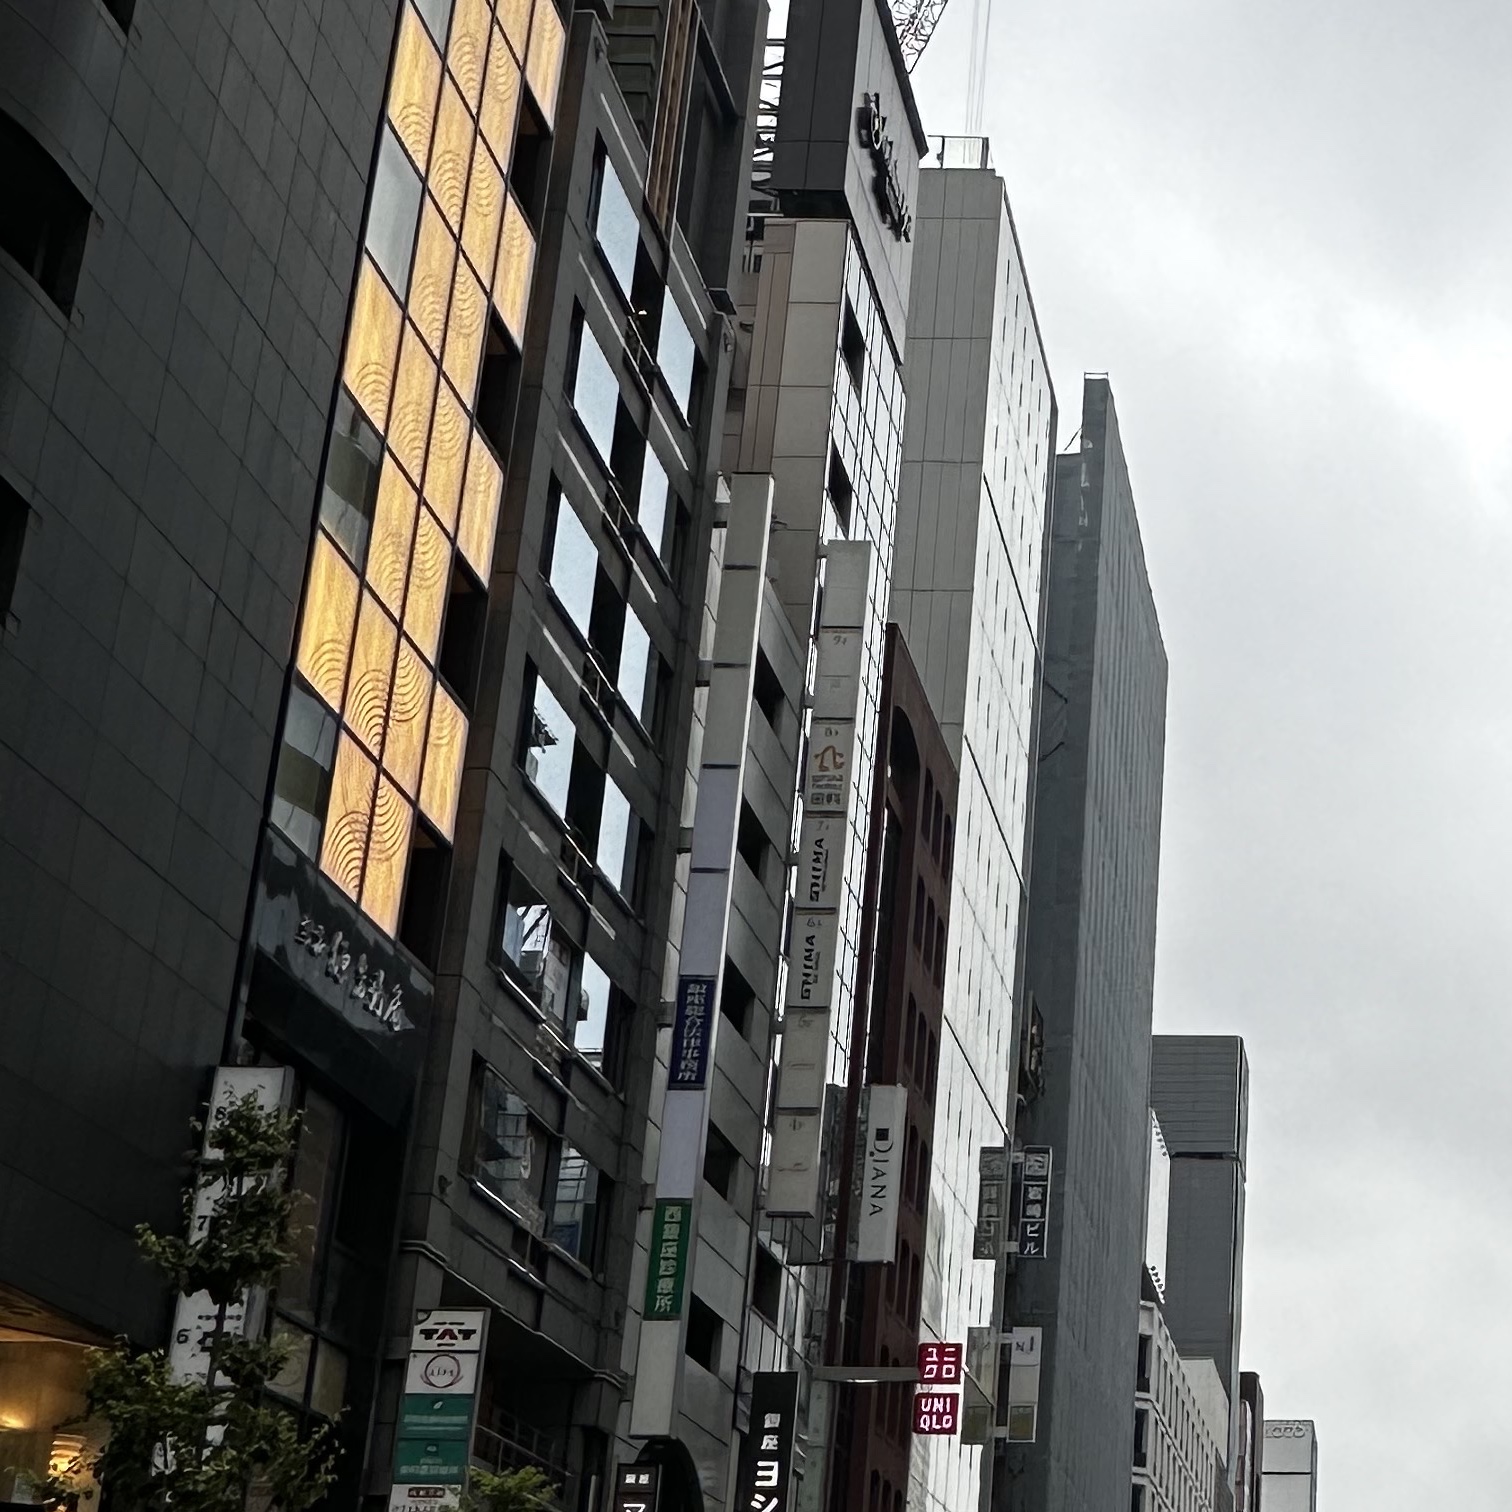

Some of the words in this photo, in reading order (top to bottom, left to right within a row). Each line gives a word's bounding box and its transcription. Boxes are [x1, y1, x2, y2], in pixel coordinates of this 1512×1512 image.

[868, 1128, 895, 1217] DIANA
[920, 1397, 951, 1413] UNI
[919, 1414, 953, 1431] QLO
